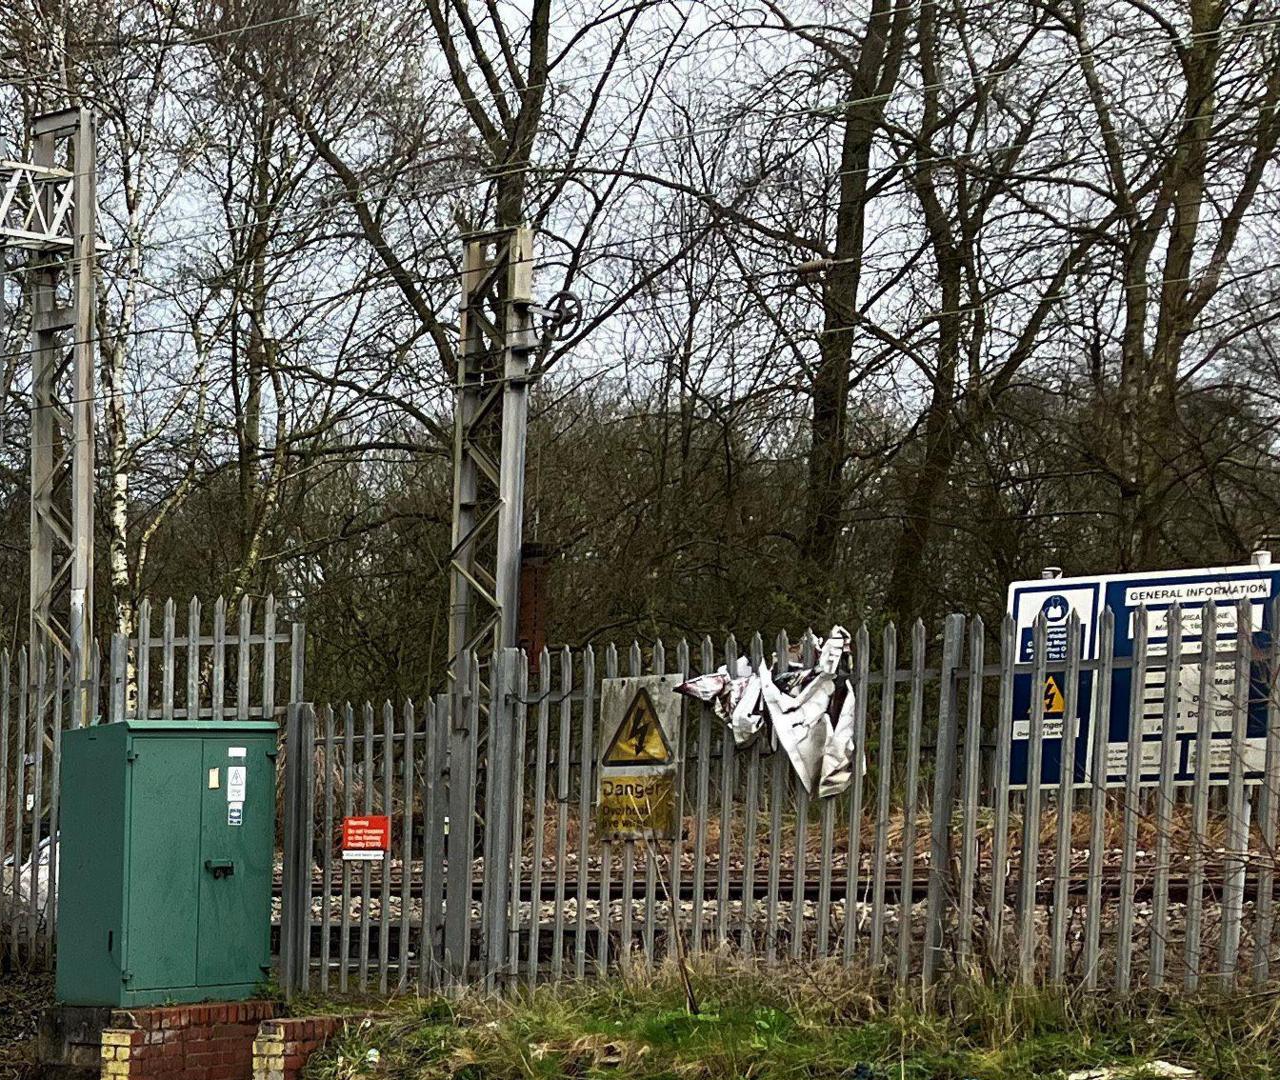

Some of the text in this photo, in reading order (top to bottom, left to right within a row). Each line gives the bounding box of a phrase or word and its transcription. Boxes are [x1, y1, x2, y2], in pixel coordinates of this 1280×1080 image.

[1130, 584, 1267, 601] GENERAL INFORMATION
[602, 780, 660, 799] Danger
